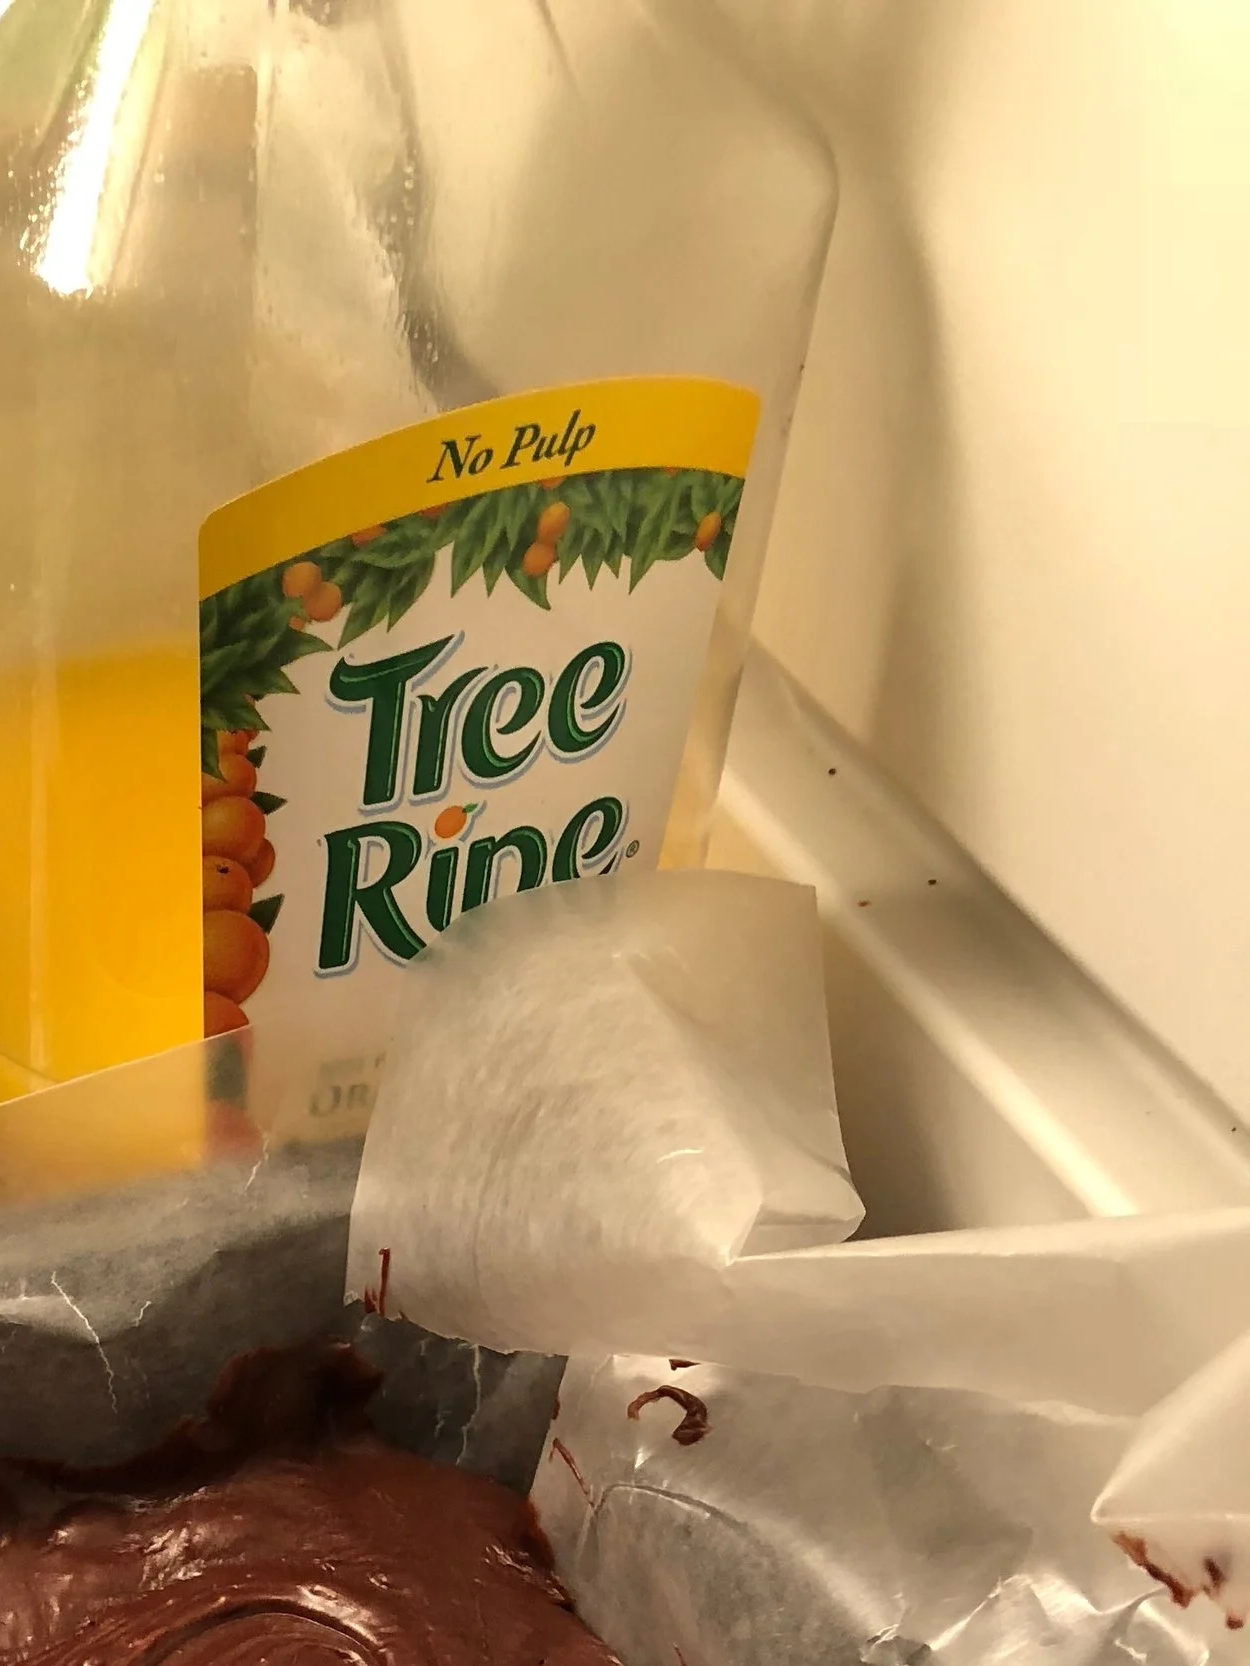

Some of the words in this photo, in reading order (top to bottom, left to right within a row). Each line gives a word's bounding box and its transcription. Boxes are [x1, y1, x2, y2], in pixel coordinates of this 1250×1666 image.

[427, 438, 495, 484] No
[500, 409, 597, 470] Pulp
[329, 633, 626, 806] Tree
